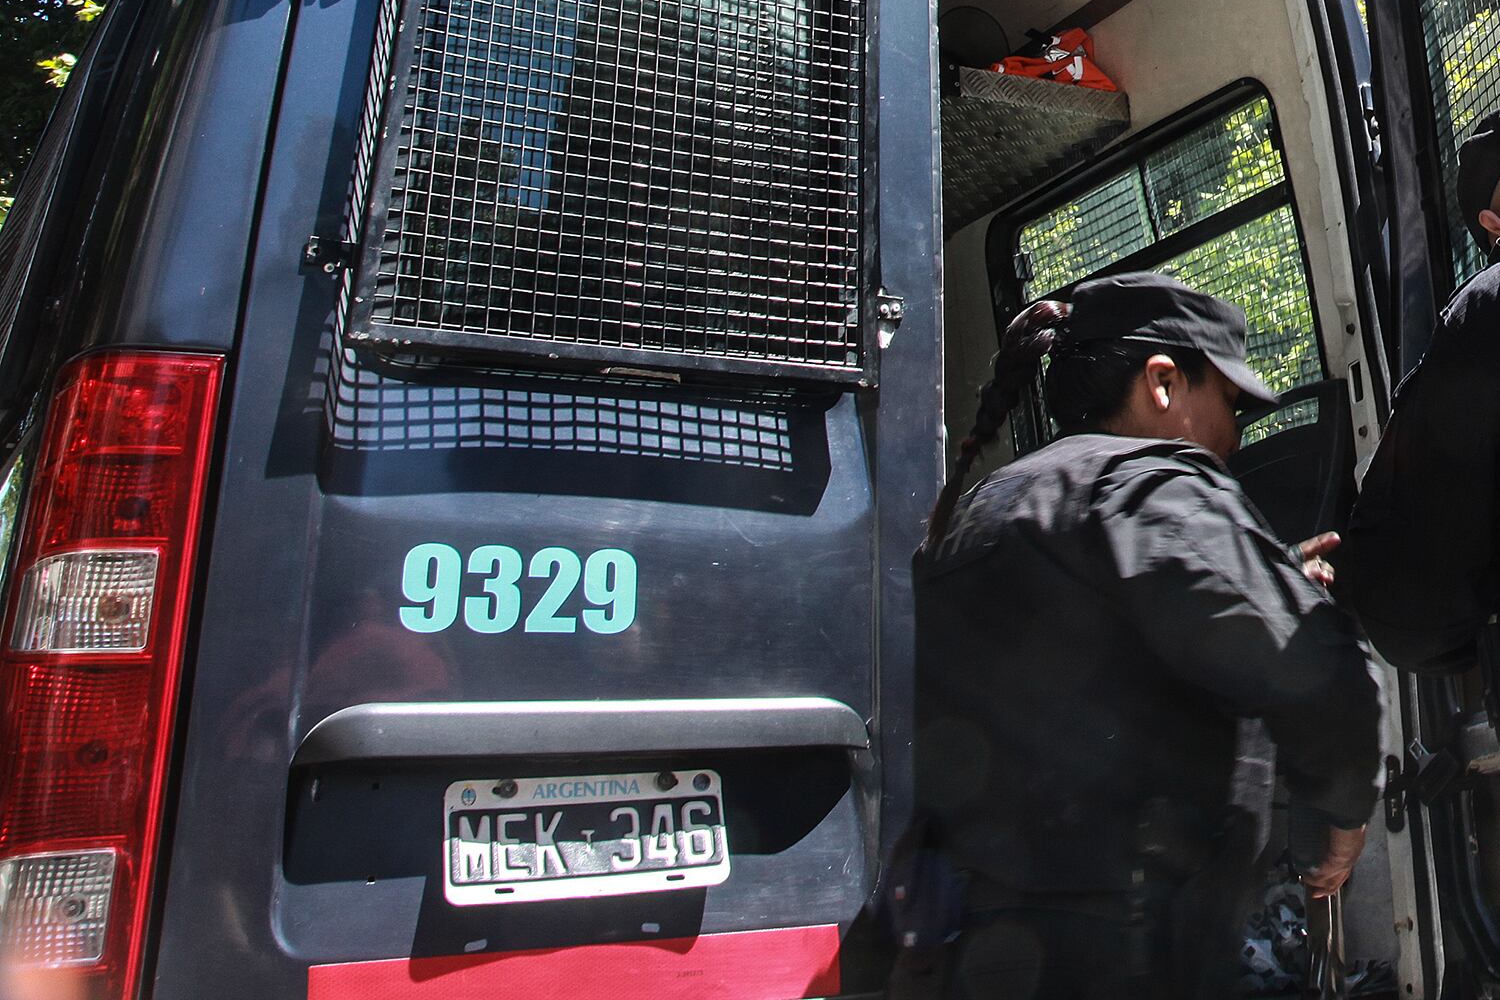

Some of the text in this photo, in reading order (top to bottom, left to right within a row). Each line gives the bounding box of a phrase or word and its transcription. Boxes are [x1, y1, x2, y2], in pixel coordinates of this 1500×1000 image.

[399, 542, 637, 635] 9329
[532, 779, 640, 799] ARGENTINA
[609, 800, 716, 870] 346
